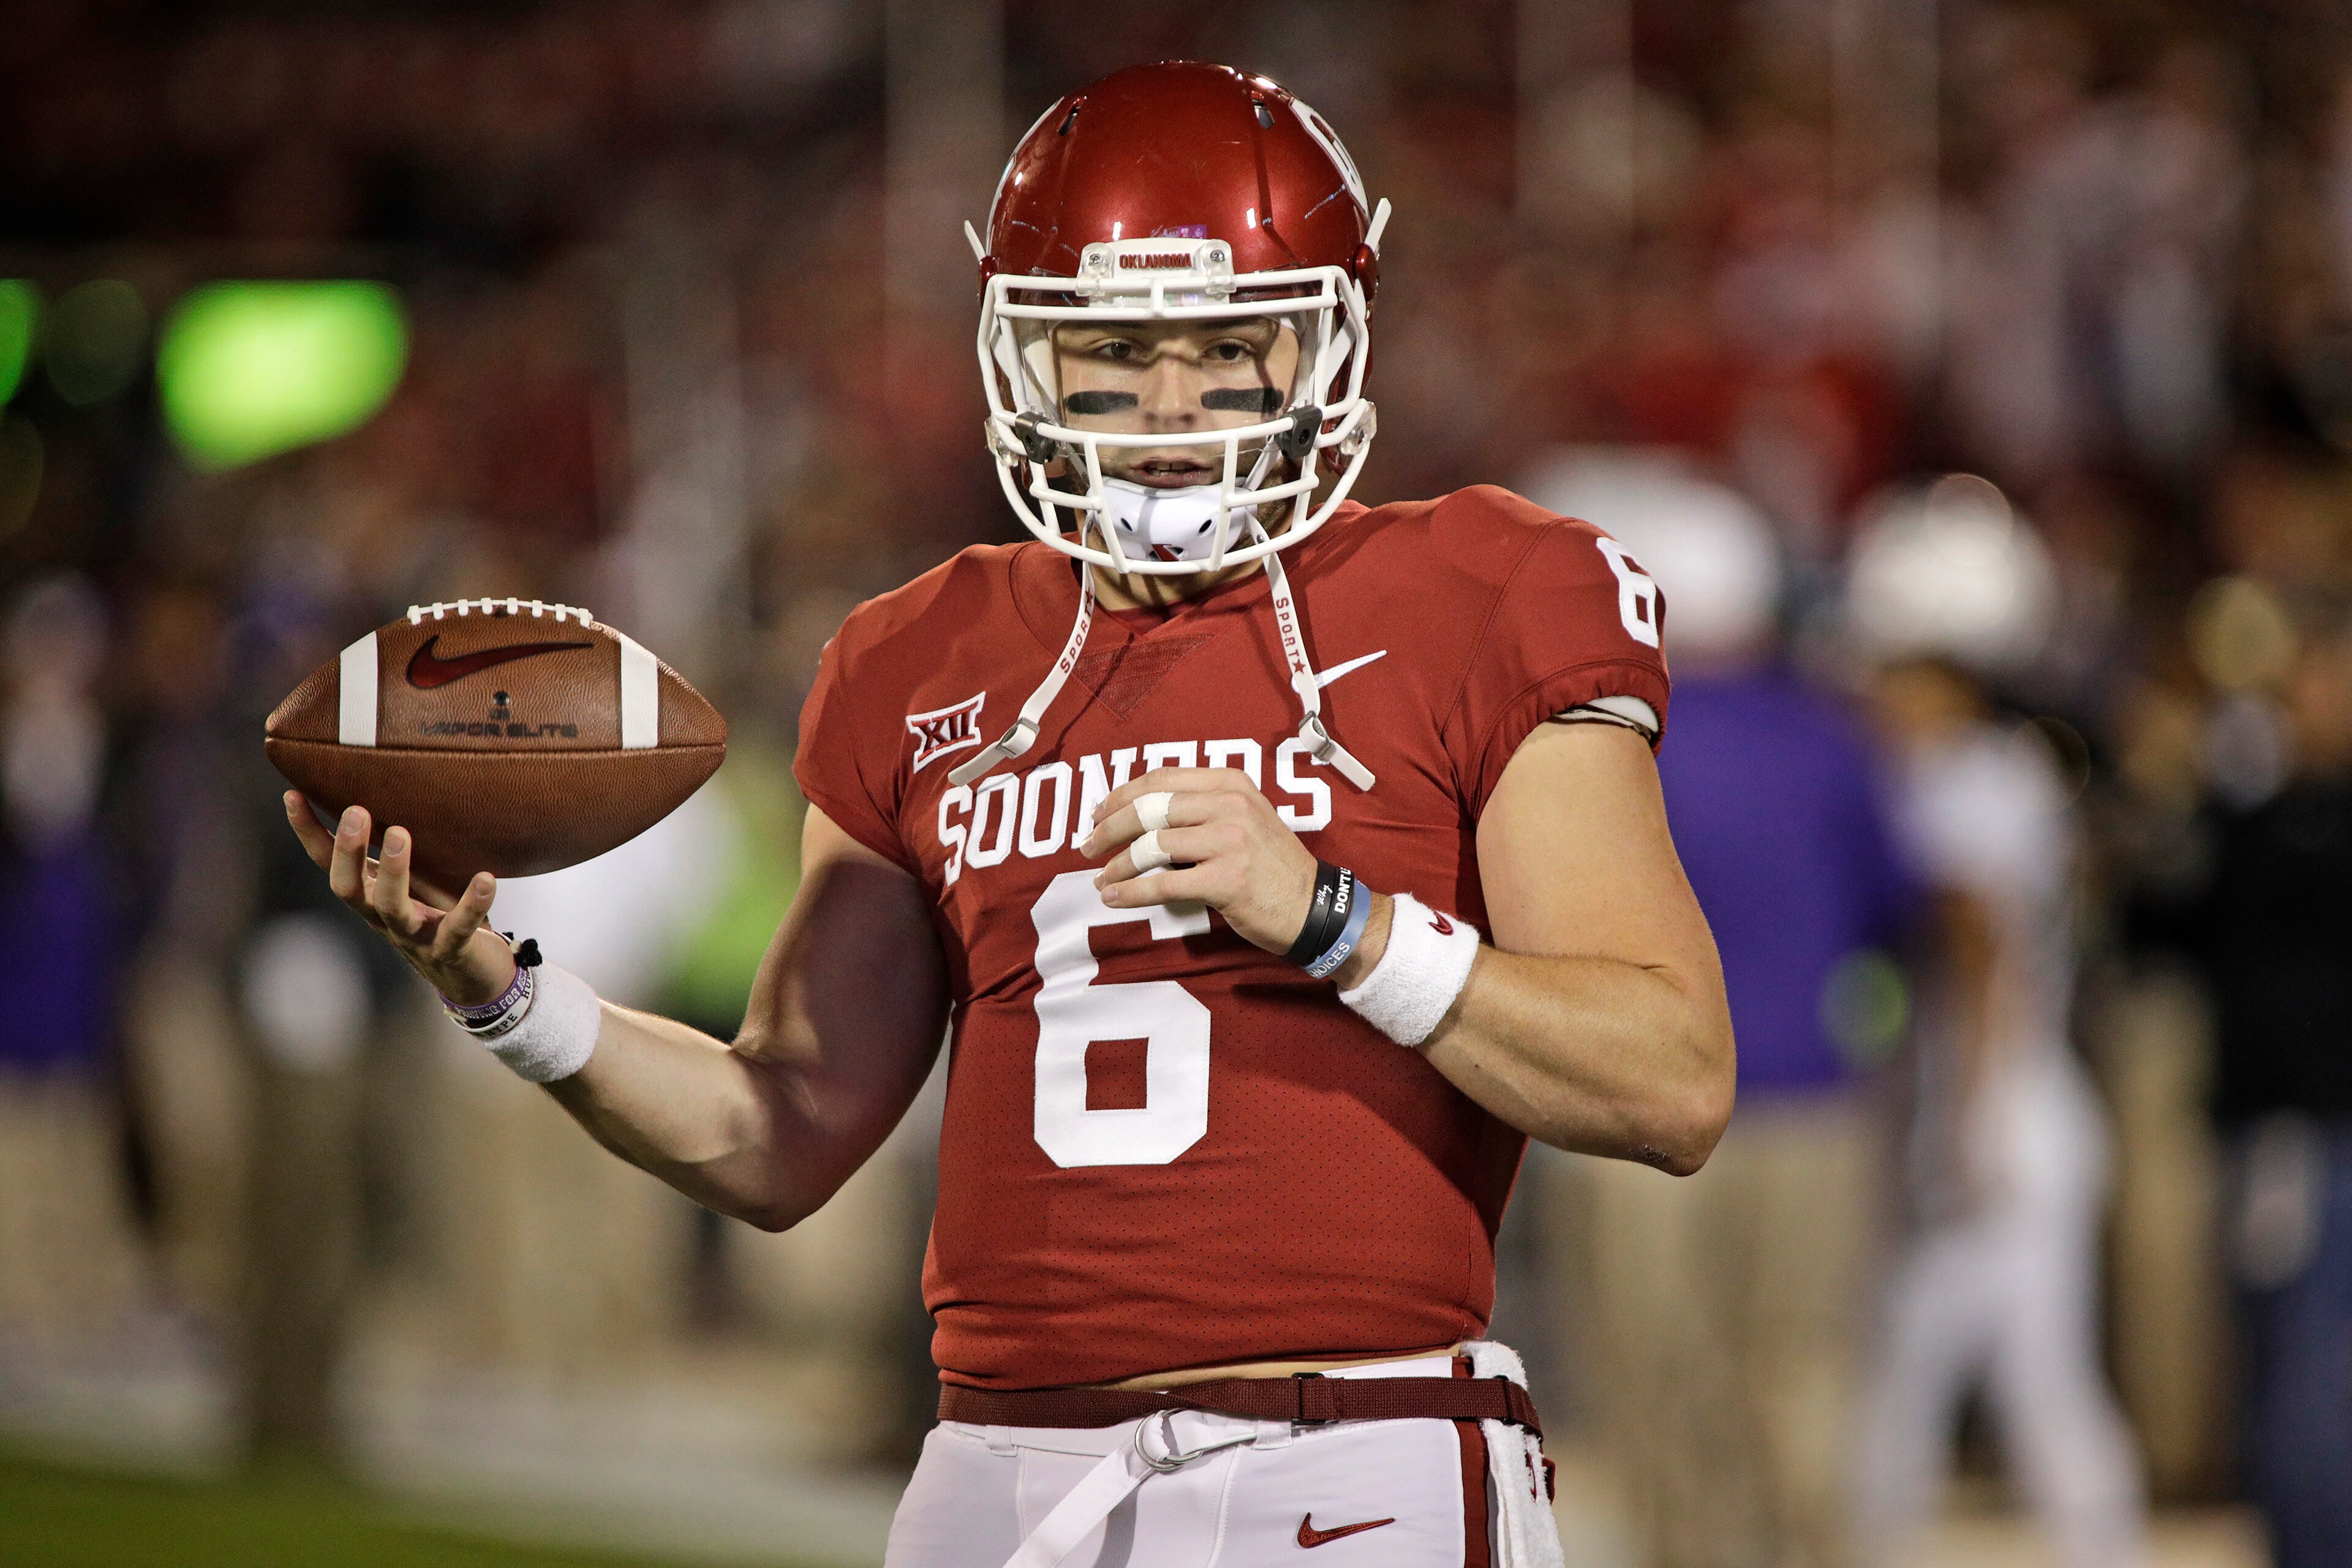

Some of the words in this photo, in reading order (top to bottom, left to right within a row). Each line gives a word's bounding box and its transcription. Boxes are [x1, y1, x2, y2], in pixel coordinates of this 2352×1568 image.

[1119, 253, 1193, 269] OKLAHOMA
[1596, 537, 1659, 649] 6
[1060, 605, 1091, 673] SPORT
[1276, 597, 1299, 657] SPORT
[1317, 884, 1333, 906] Why
[1334, 873, 1352, 914] DON'T
[1309, 942, 1351, 978] CHOICES
[499, 987, 521, 1009] FOR
[1030, 866, 1212, 1168] 6
[484, 1013, 518, 1036] HYPE
